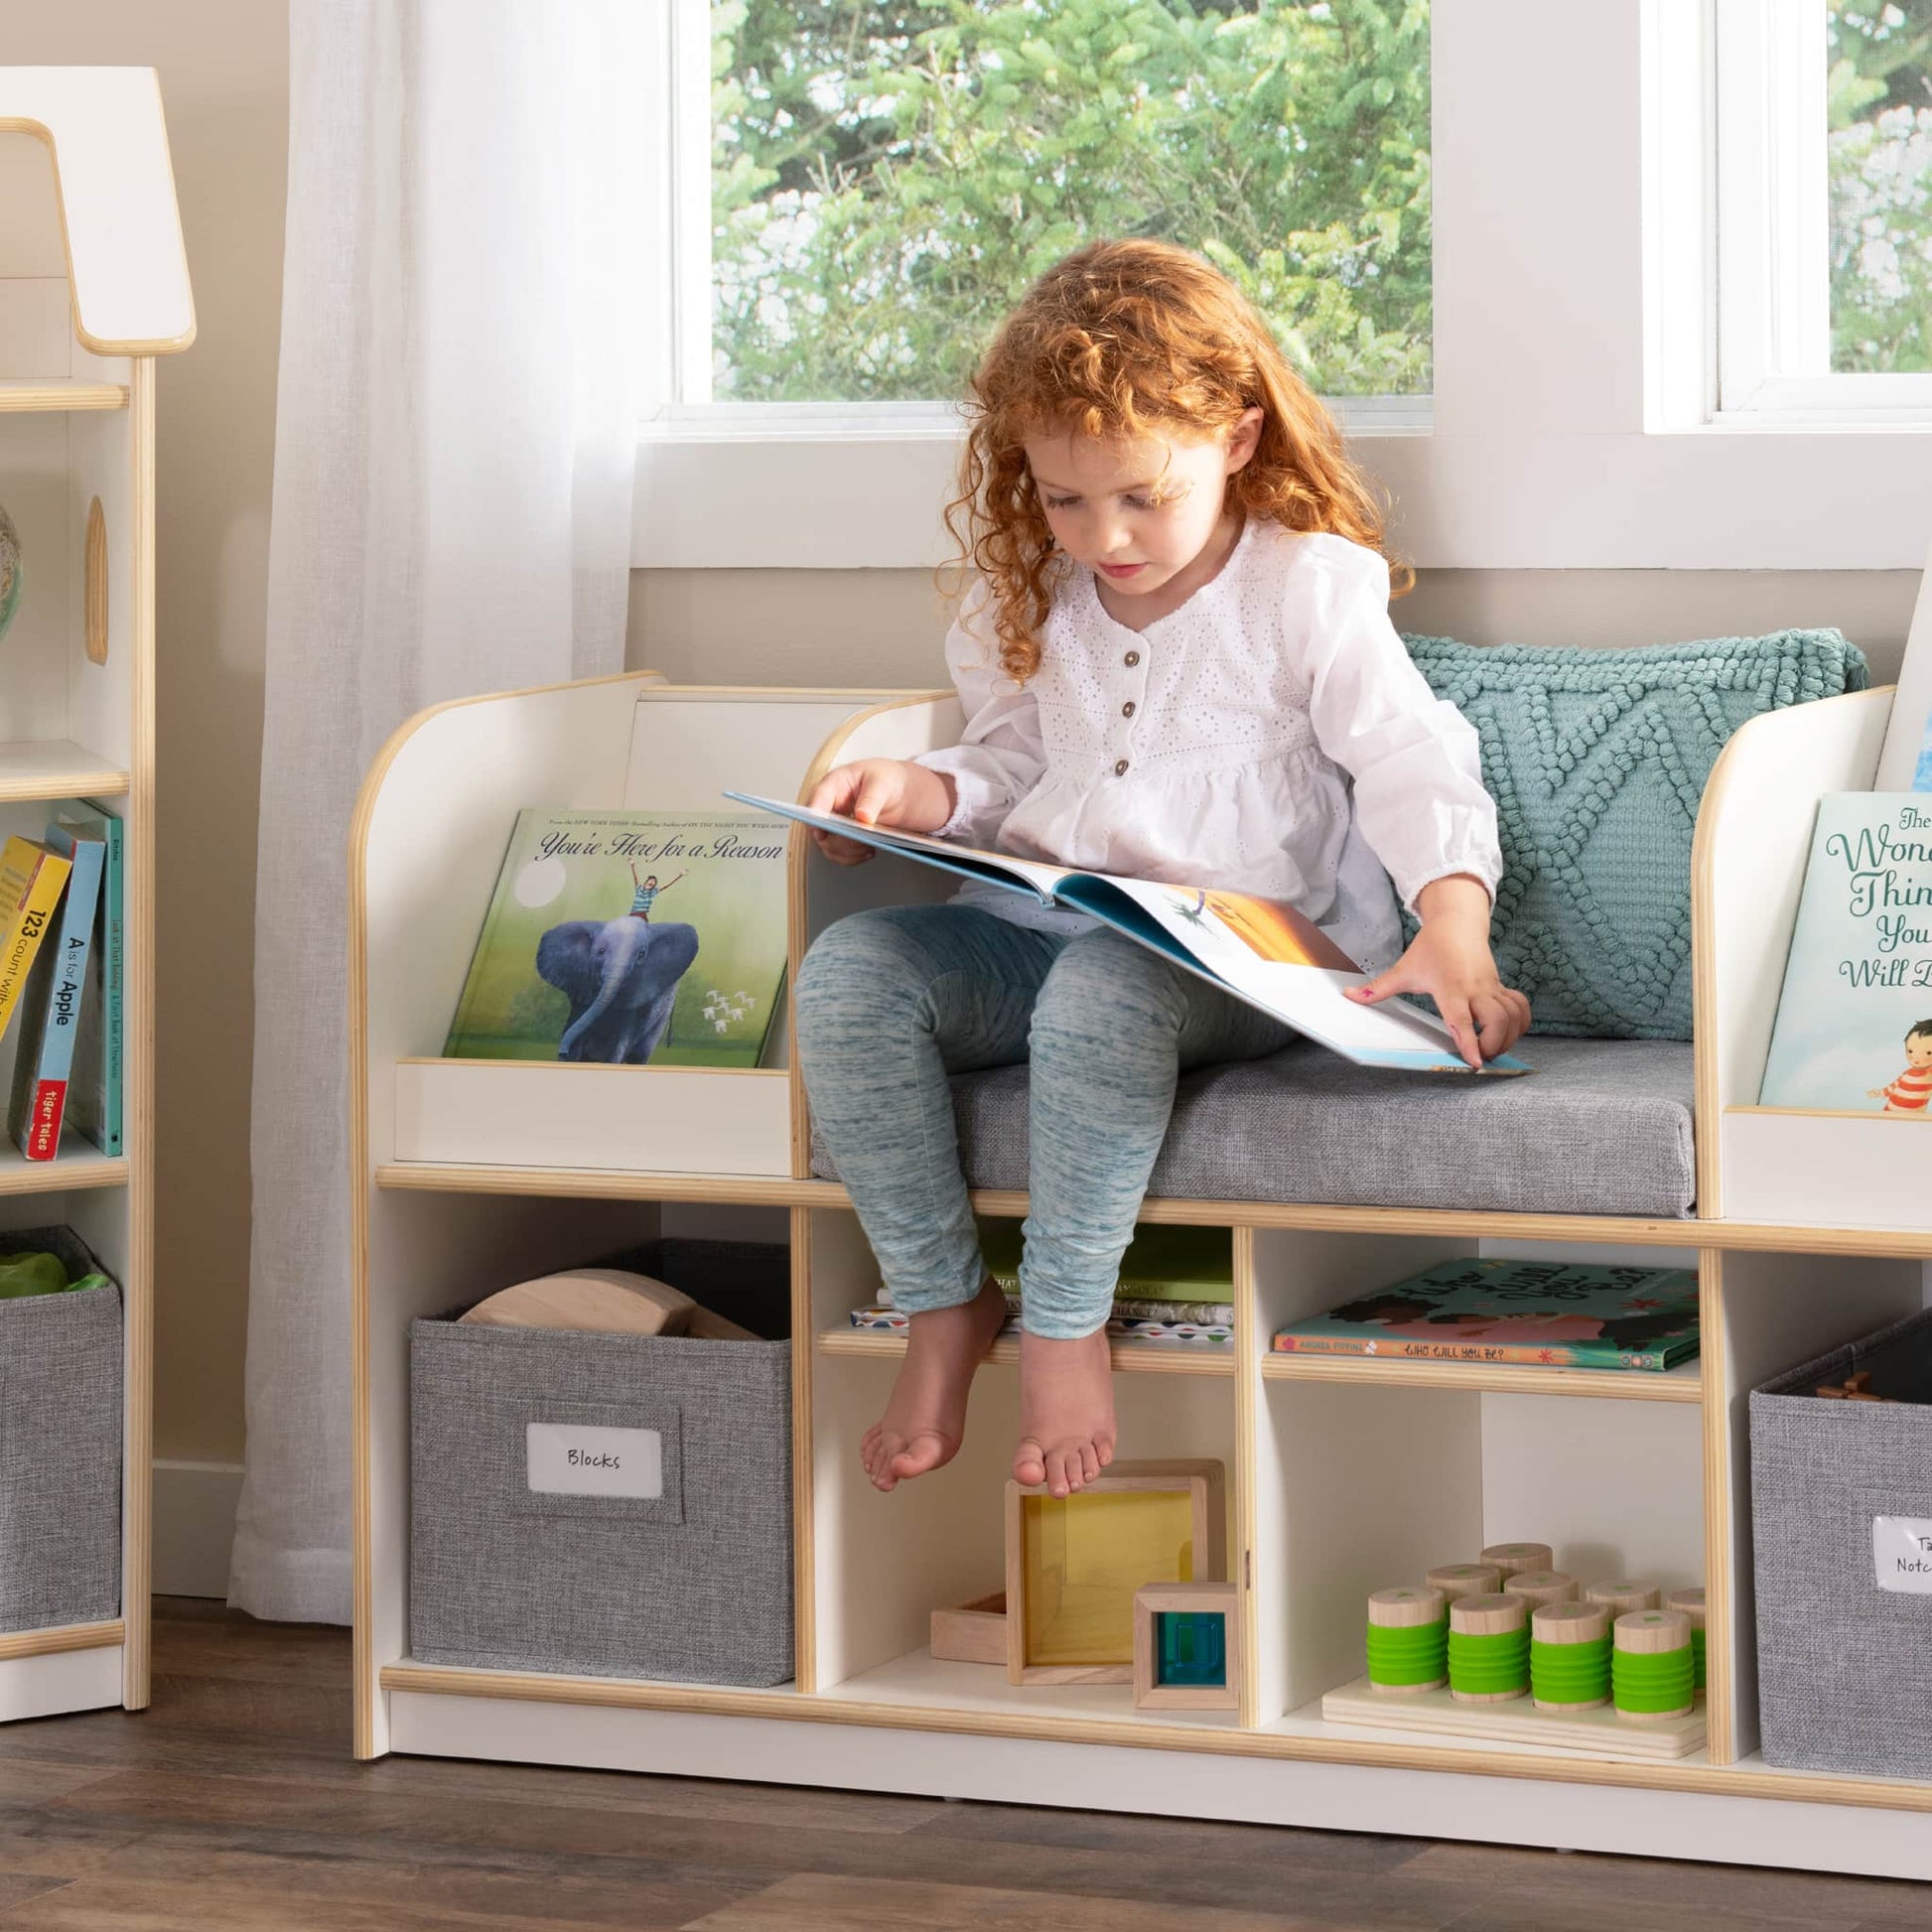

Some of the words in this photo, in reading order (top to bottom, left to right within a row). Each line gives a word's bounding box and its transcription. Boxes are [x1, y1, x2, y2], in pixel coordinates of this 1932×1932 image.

[1898, 807, 1932, 831] The
[533, 831, 603, 862] You're
[604, 832, 657, 857] Here
[644, 834, 686, 863] for
[688, 844, 705, 857] a
[704, 834, 783, 859] Reason
[21, 909, 47, 938] 123
[1875, 914, 1932, 953] You
[68, 950, 78, 961] is
[69, 936, 85, 949] A
[7, 938, 28, 976] count
[66, 962, 78, 979] for
[1838, 958, 1910, 988] Will
[56, 980, 78, 1027] Apple
[43, 1090, 58, 1122] tiger
[38, 1122, 53, 1152] tales
[1404, 1343, 1430, 1357] WHO
[1433, 1344, 1459, 1359] WILL
[1460, 1346, 1481, 1359] YOU
[568, 1449, 621, 1469] Blocks
[1916, 1537, 1932, 1552] Ta
[1897, 1557, 1932, 1573] Notc
